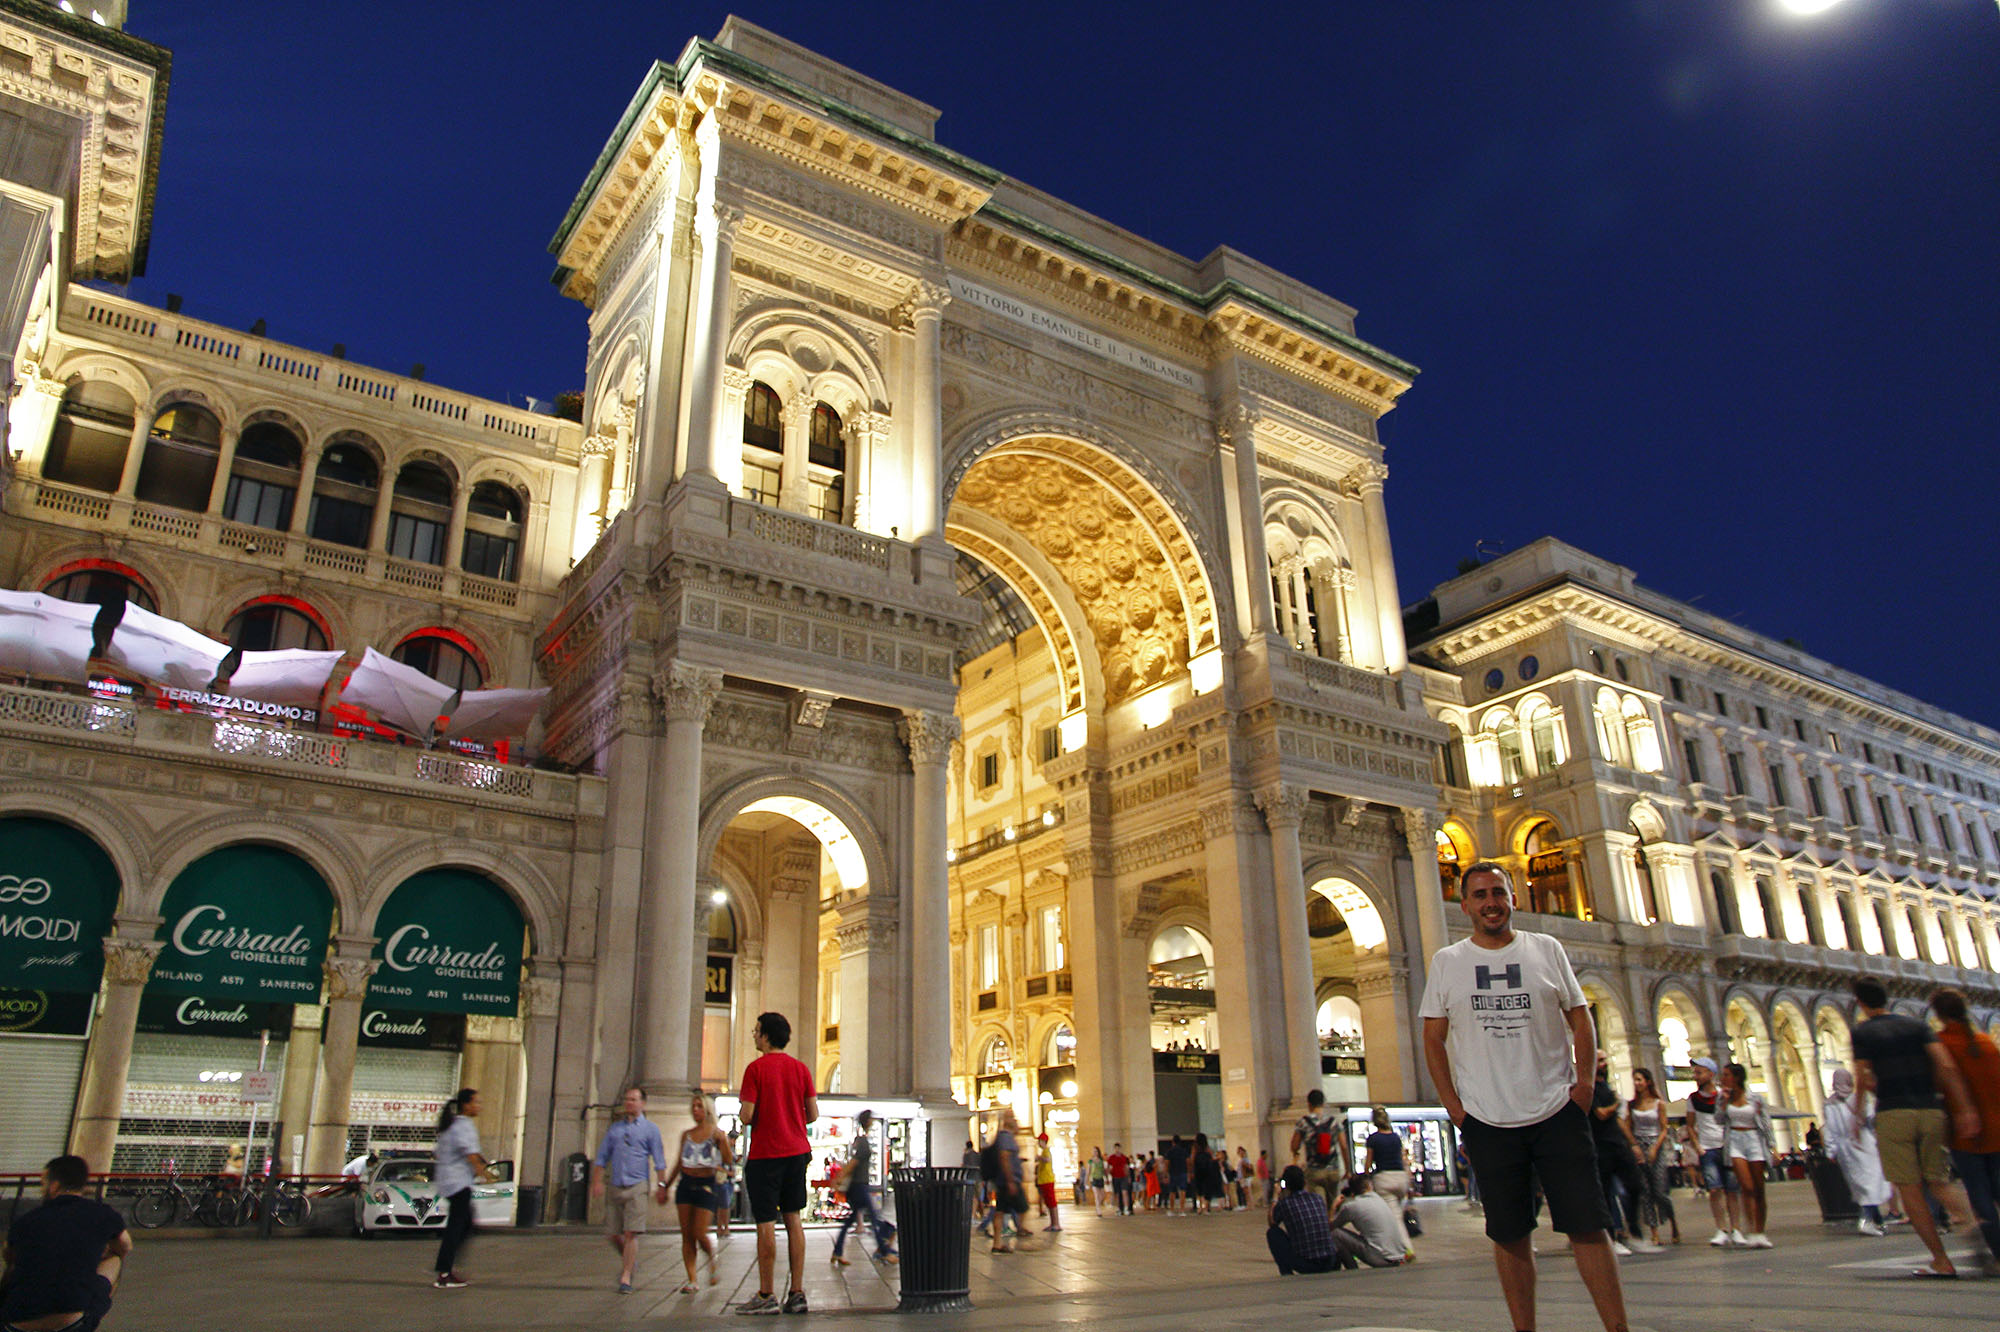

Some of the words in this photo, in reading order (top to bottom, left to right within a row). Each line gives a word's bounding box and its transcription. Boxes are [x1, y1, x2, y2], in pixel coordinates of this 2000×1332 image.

[960, 284, 1024, 318] VITTORIO
[1031, 312, 1101, 349] EMANUELE
[1139, 356, 1193, 386] MILANESI
[88, 680, 133, 695] MARTINI
[160, 686, 243, 711] TERRAZZA
[243, 699, 301, 720] DUOMO
[302, 710, 315, 722] 21
[337, 721, 375, 734] MARTINI
[450, 739, 484, 751] MARTINI
[172, 904, 312, 956] Currado
[230, 950, 308, 967] GIOIELLERIE
[384, 924, 507, 972] Currado
[155, 969, 204, 982] MILANO
[220, 976, 244, 986] ASTI
[259, 979, 315, 991] SANREMO
[435, 966, 503, 981] GIOIELLERIE
[370, 984, 413, 996] MILANO
[427, 989, 448, 999] ASTI
[462, 993, 511, 1004] SANREMO
[1472, 995, 1530, 1010] HILFIGER
[176, 996, 249, 1025] Currado
[362, 1010, 427, 1038] Currado
